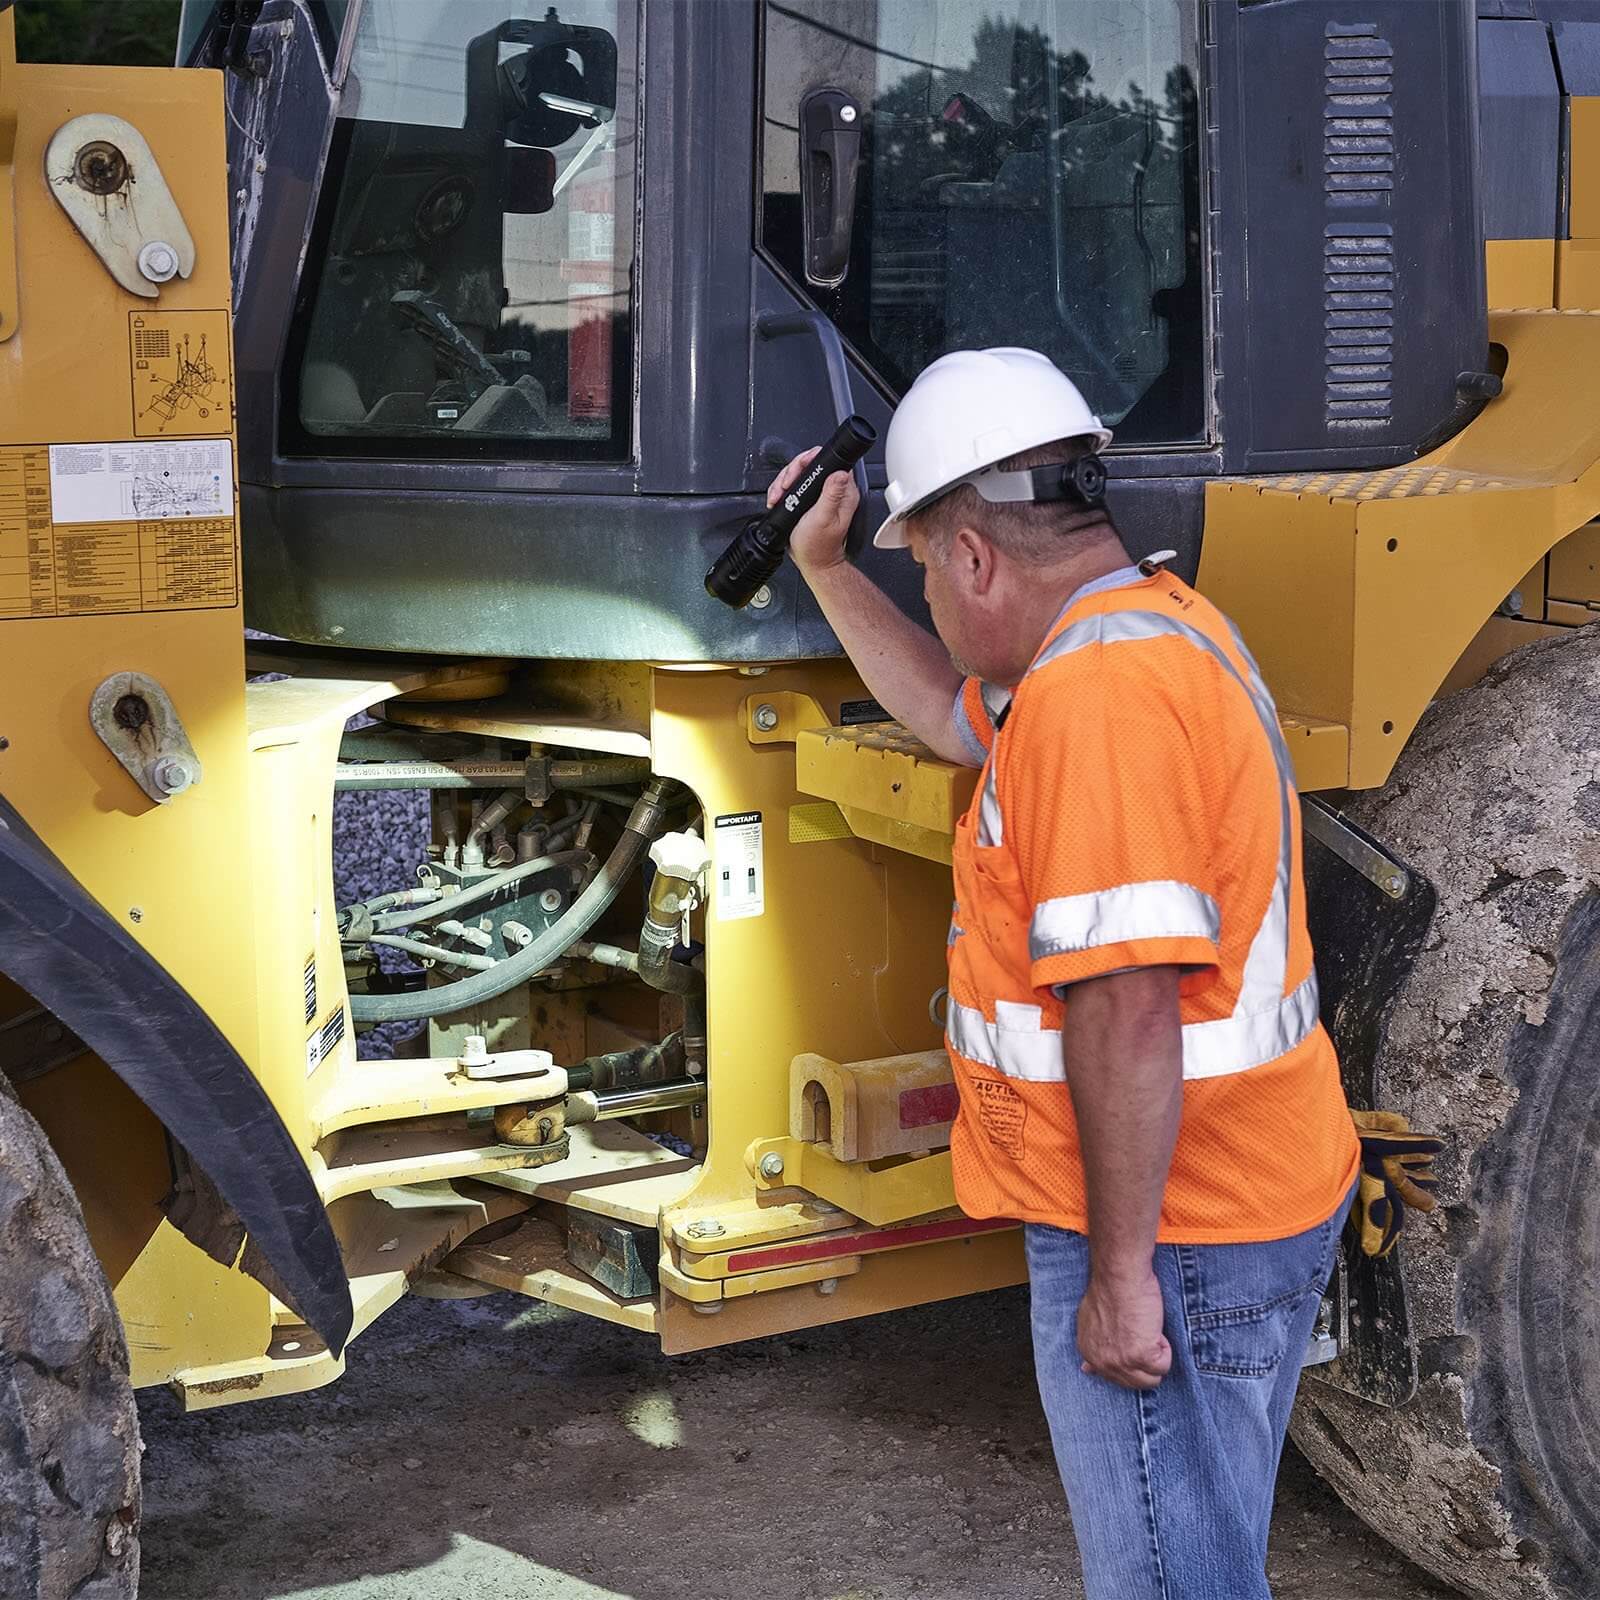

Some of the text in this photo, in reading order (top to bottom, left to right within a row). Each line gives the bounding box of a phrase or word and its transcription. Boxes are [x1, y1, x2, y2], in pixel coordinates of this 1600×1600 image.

[796, 464, 824, 497] KODIAK
[717, 815, 759, 826] PORTANT
[971, 1080, 1020, 1097] AUTIO
